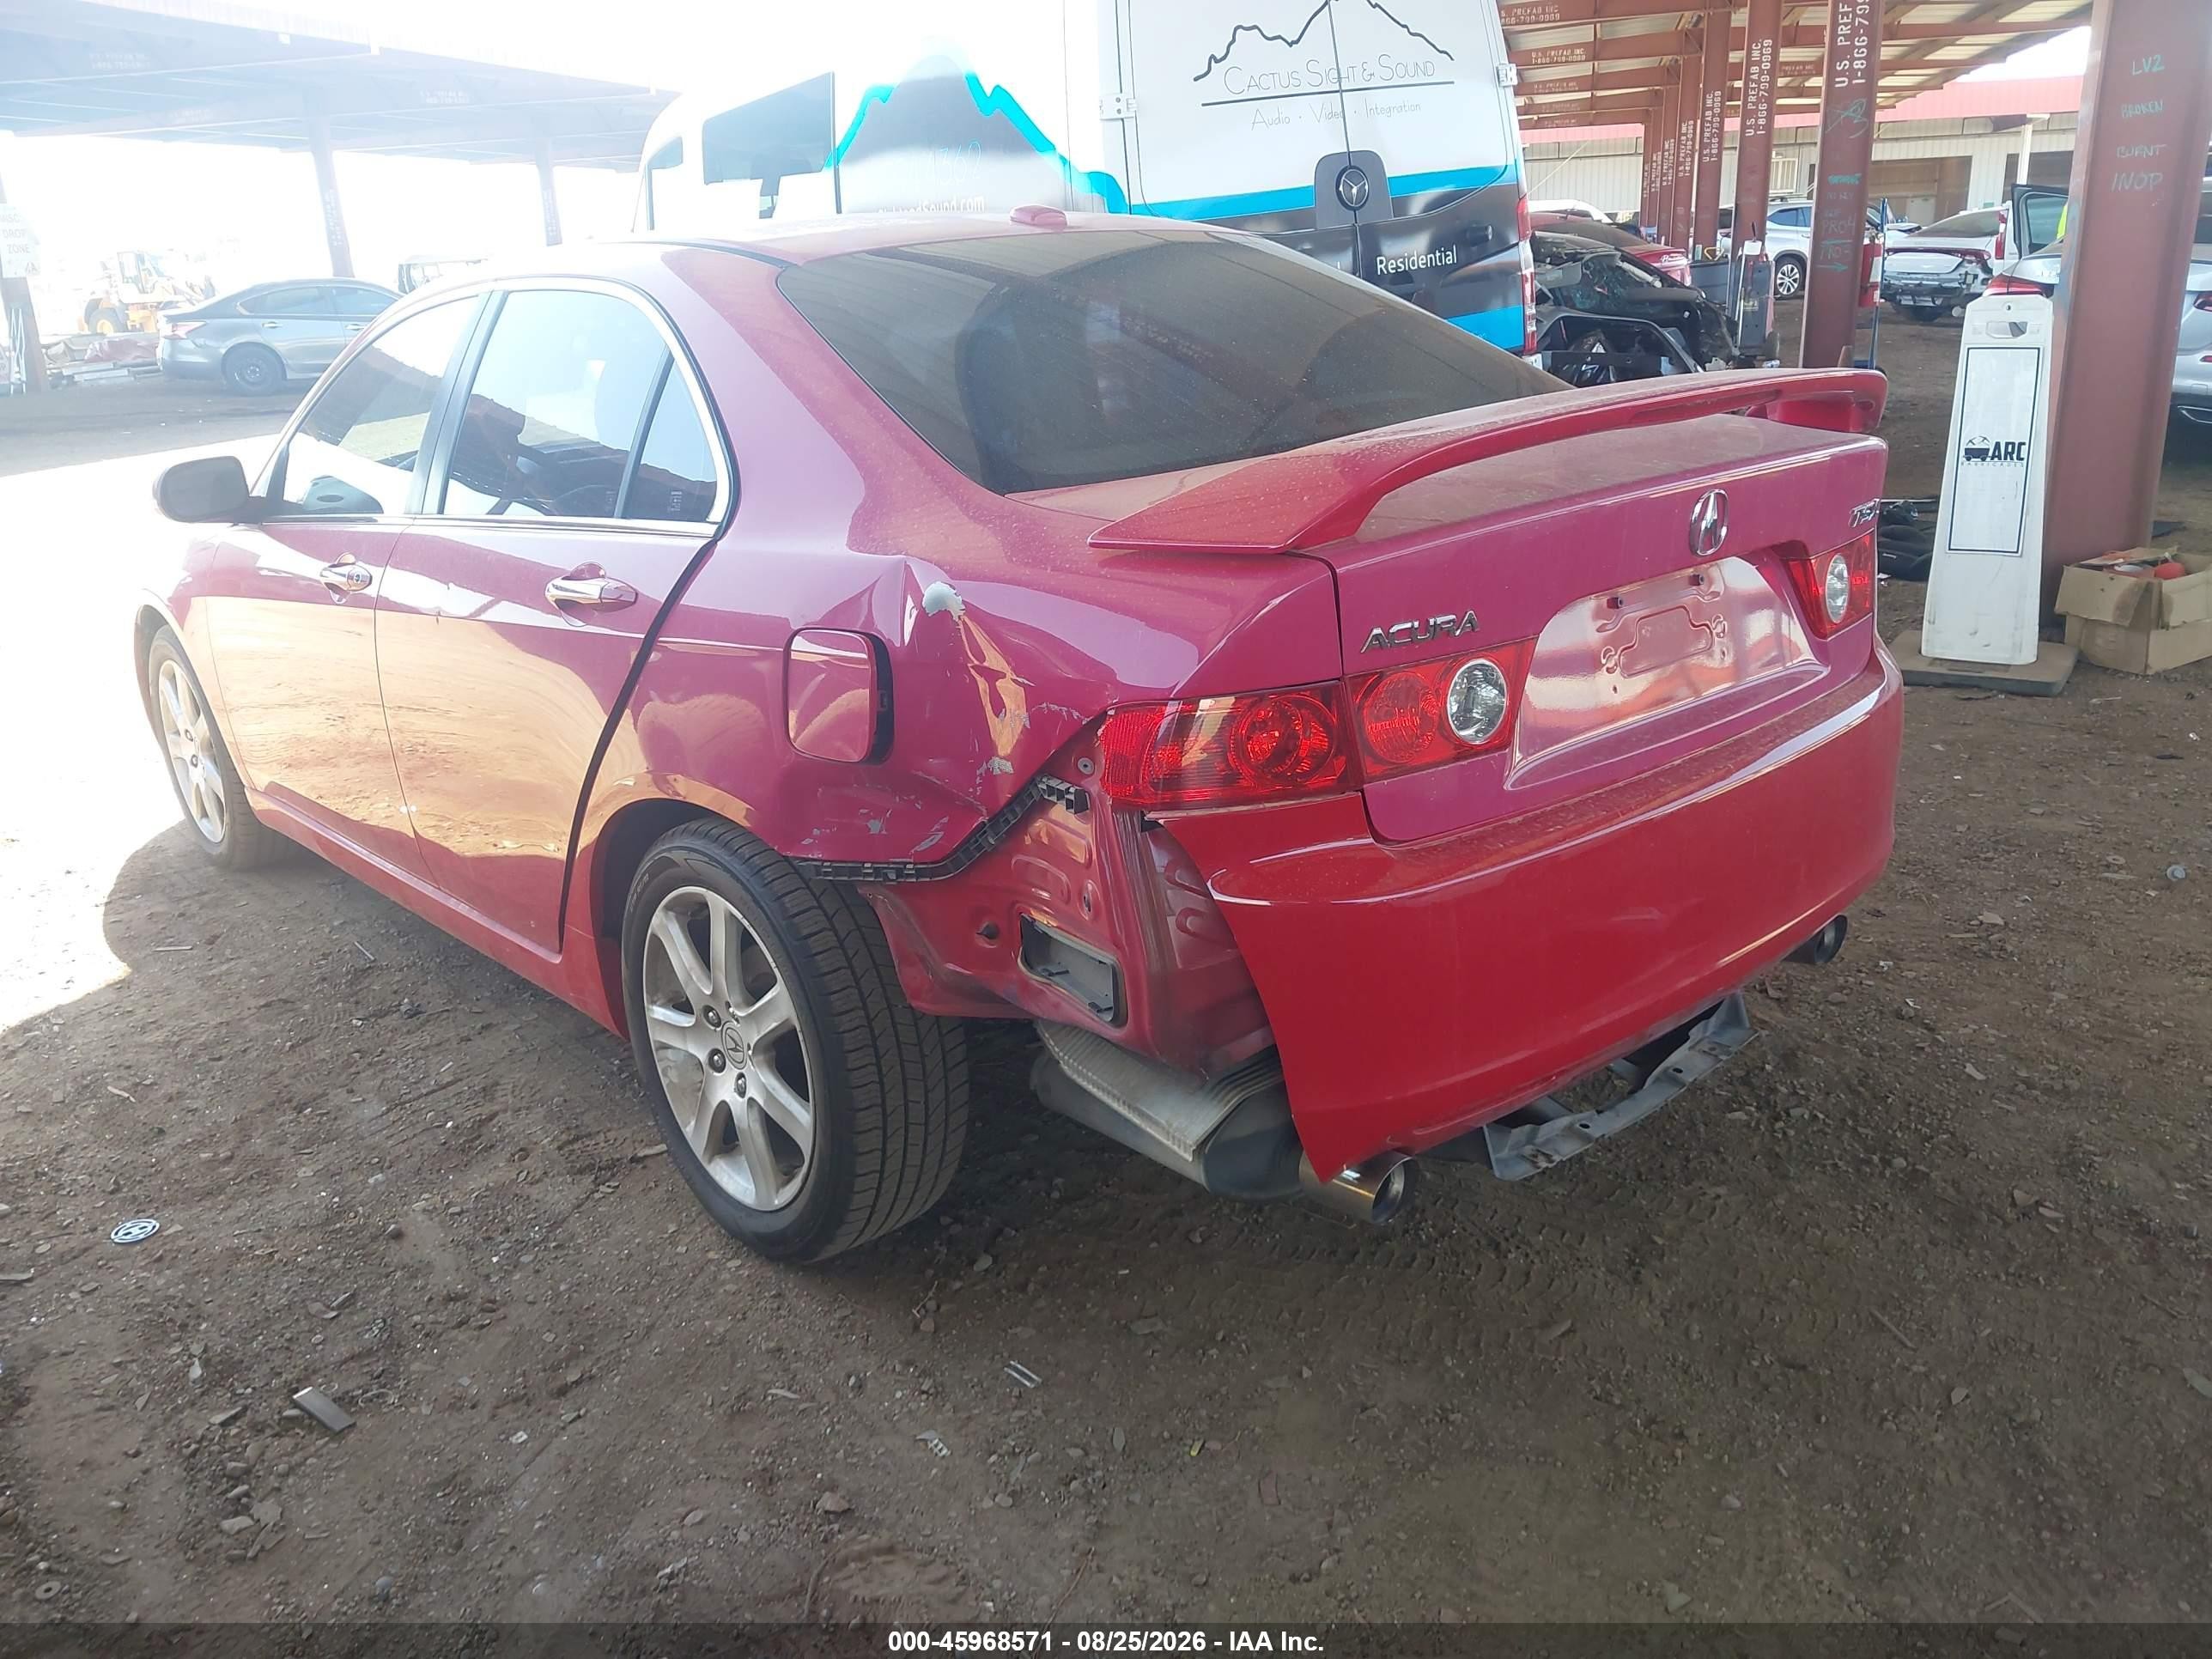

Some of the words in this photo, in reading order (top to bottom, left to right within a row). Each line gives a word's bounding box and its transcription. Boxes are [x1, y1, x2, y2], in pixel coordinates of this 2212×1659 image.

[1837, 2, 1852, 46] PREF
[1751, 39, 1762, 61] INC.
[2131, 54, 2165, 76] LV2
[1224, 65, 1303, 94] CACTUS
[1306, 59, 1358, 88] SIGHT
[1361, 61, 1376, 82] &
[1377, 53, 1436, 82] SOUND
[1747, 65, 1759, 110] PREFAB
[1834, 54, 1850, 88] U.S.
[1250, 106, 1291, 131] Audio
[1308, 102, 1345, 124] Video
[1364, 96, 1422, 118] Integration
[1745, 116, 1756, 137] U.S.
[2111, 172, 2163, 191] INOP
[1376, 244, 1458, 276] Residential
[1990, 441, 2027, 461] ARC
[1359, 609, 1480, 654] ACURA
